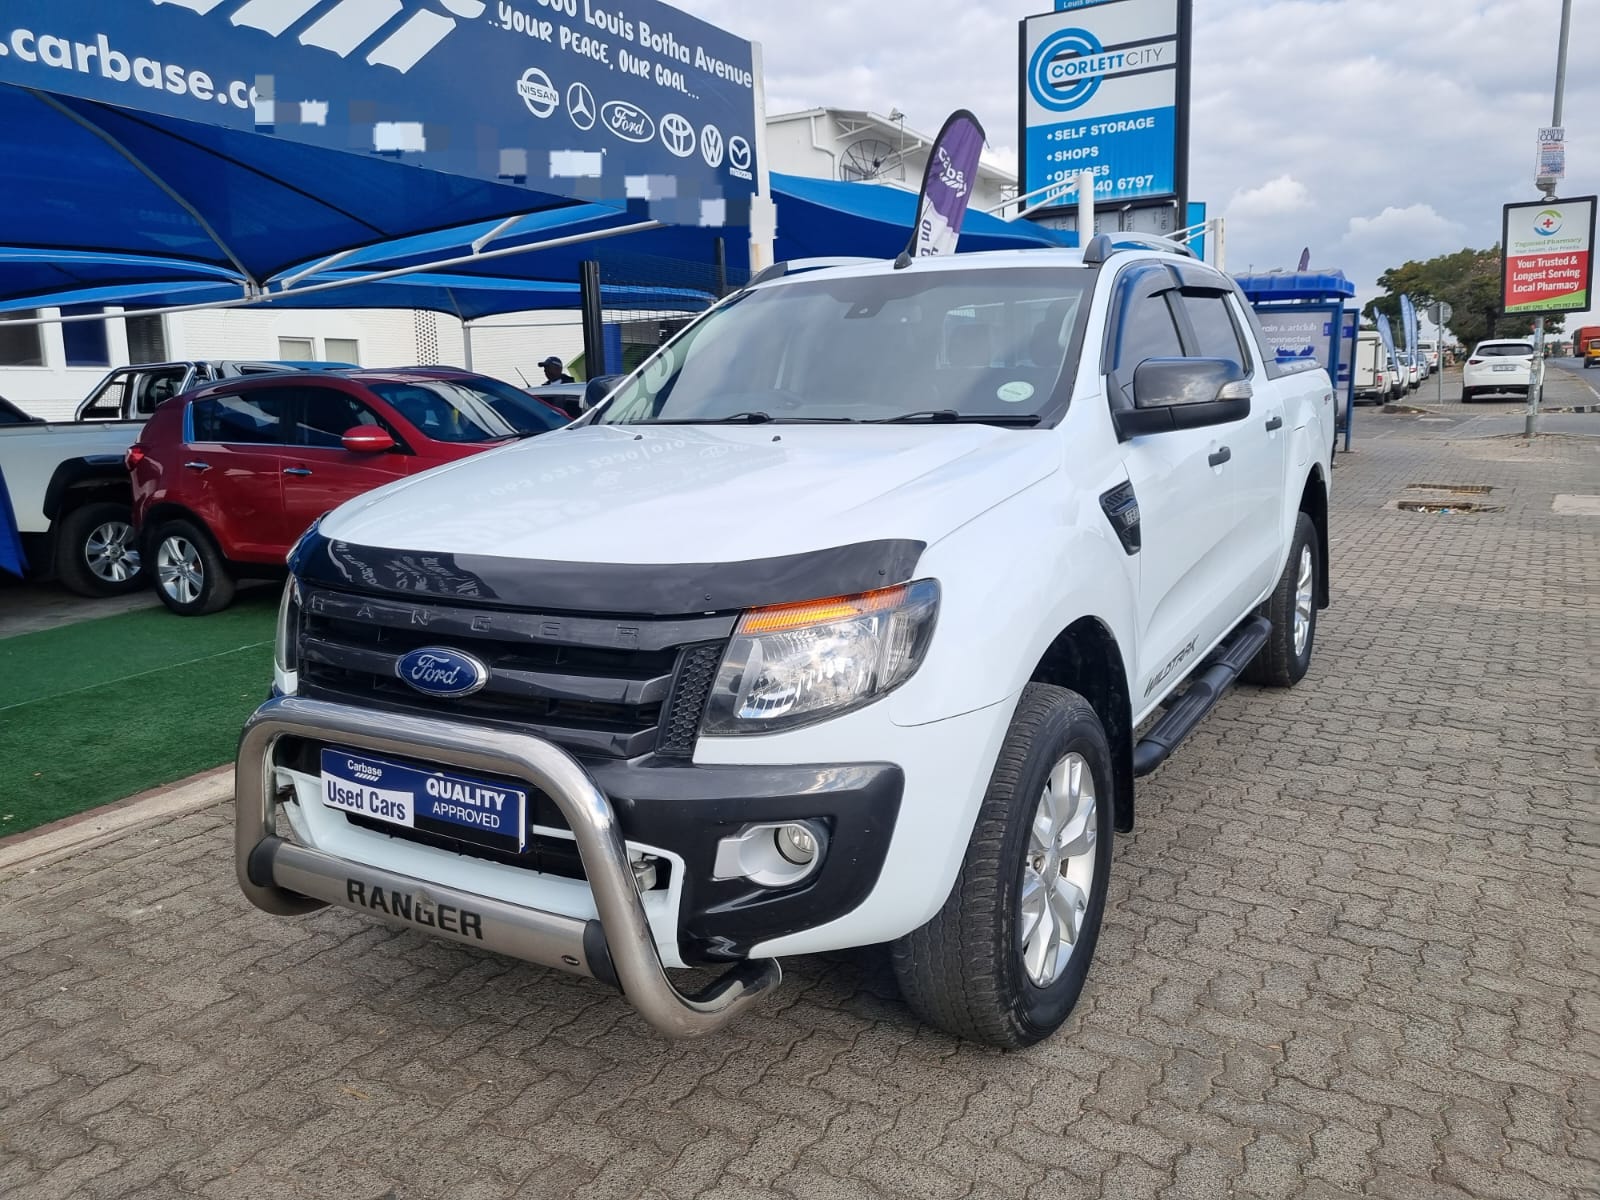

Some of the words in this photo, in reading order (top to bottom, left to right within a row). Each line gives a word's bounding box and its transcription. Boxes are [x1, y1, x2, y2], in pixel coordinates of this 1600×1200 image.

[584, 0, 634, 41] Louis
[640, 21, 690, 64] Botha
[695, 46, 753, 88] Avenue
[618, 49, 650, 79] OUR
[520, 83, 557, 102] NISSAN
[611, 106, 646, 136] Ford
[1054, 127, 1087, 141] SELF
[1090, 117, 1155, 136] STORAGE
[1054, 146, 1099, 162] SHOPS
[1117, 175, 1154, 190] 6797
[1513, 270, 1546, 281] Longest
[1548, 268, 1581, 279] Serving
[1517, 259, 1536, 269] Your
[1537, 256, 1569, 267] Trusted
[1570, 255, 1578, 265] &
[1513, 282, 1536, 293] Local
[1537, 280, 1579, 291] Pharmacy
[411, 654, 457, 685] Ford
[347, 759, 383, 778] Carbase
[327, 779, 364, 810] Used
[369, 790, 406, 821] Cars
[425, 777, 506, 811] QUALITY
[432, 802, 500, 829] APPROVED
[347, 878, 483, 940] RANGER
